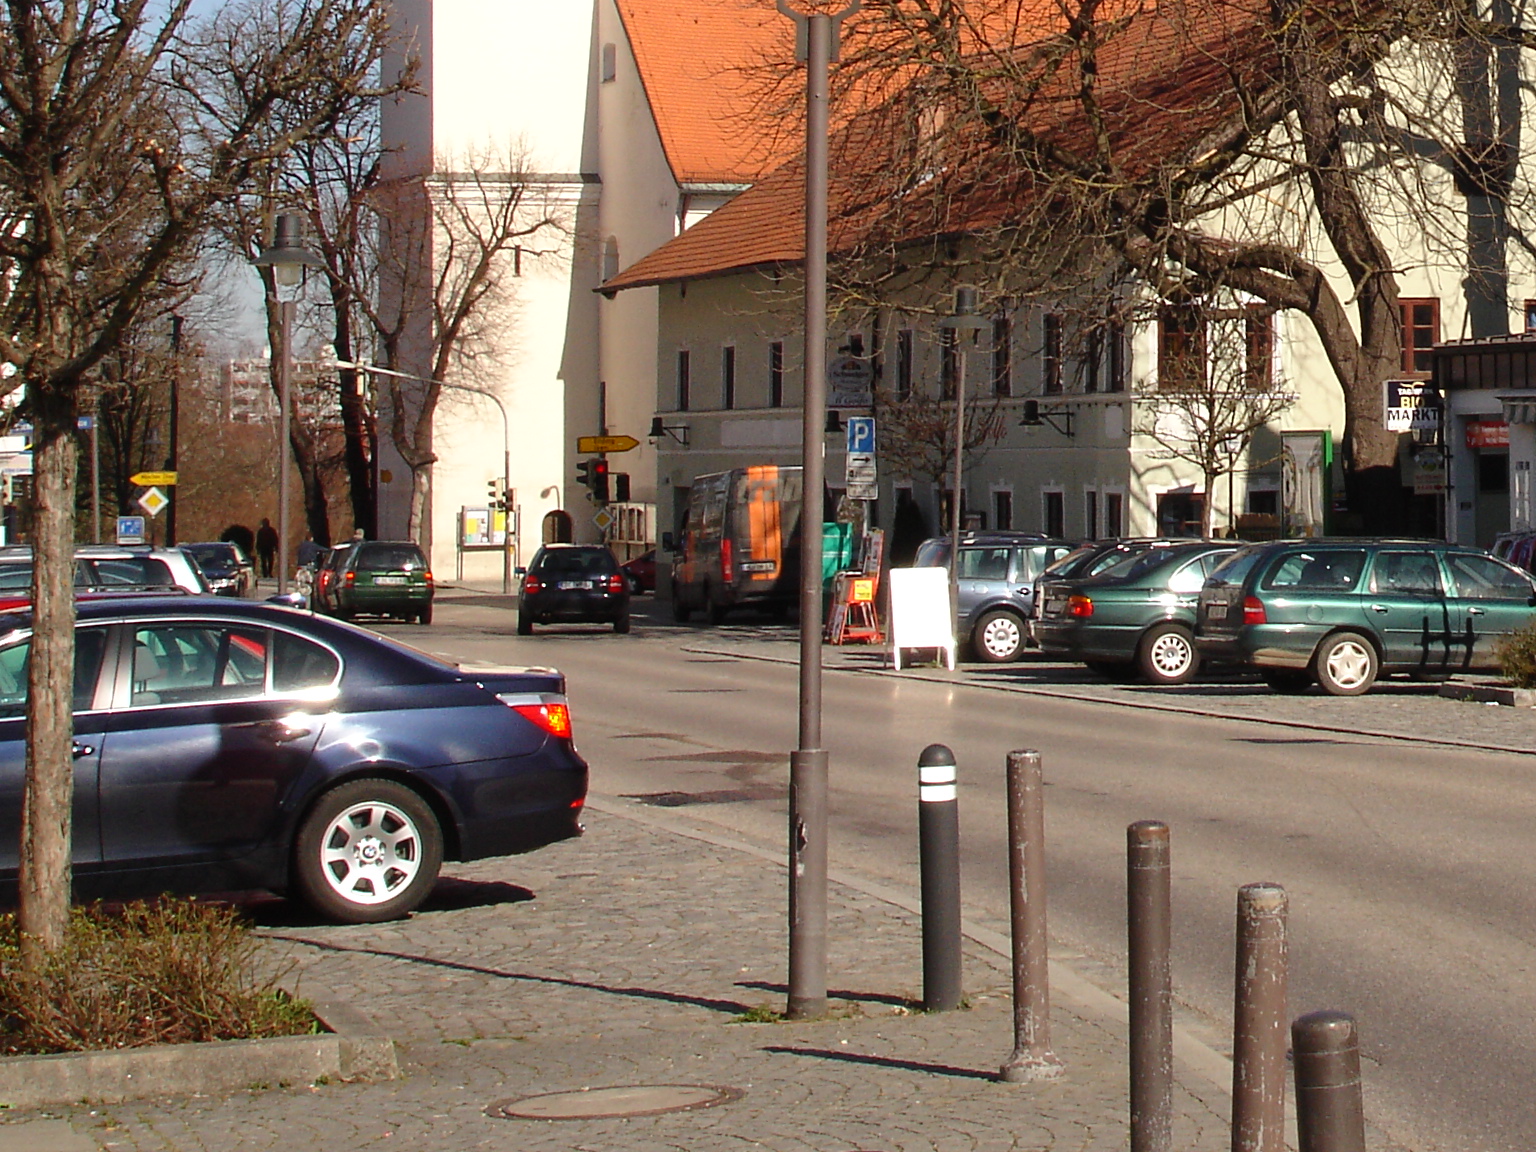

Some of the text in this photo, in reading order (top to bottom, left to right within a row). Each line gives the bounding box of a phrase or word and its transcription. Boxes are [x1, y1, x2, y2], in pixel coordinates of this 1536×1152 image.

[1400, 395, 1426, 409] BIO
[1387, 408, 1438, 422] MARKT
[854, 422, 870, 450] P
